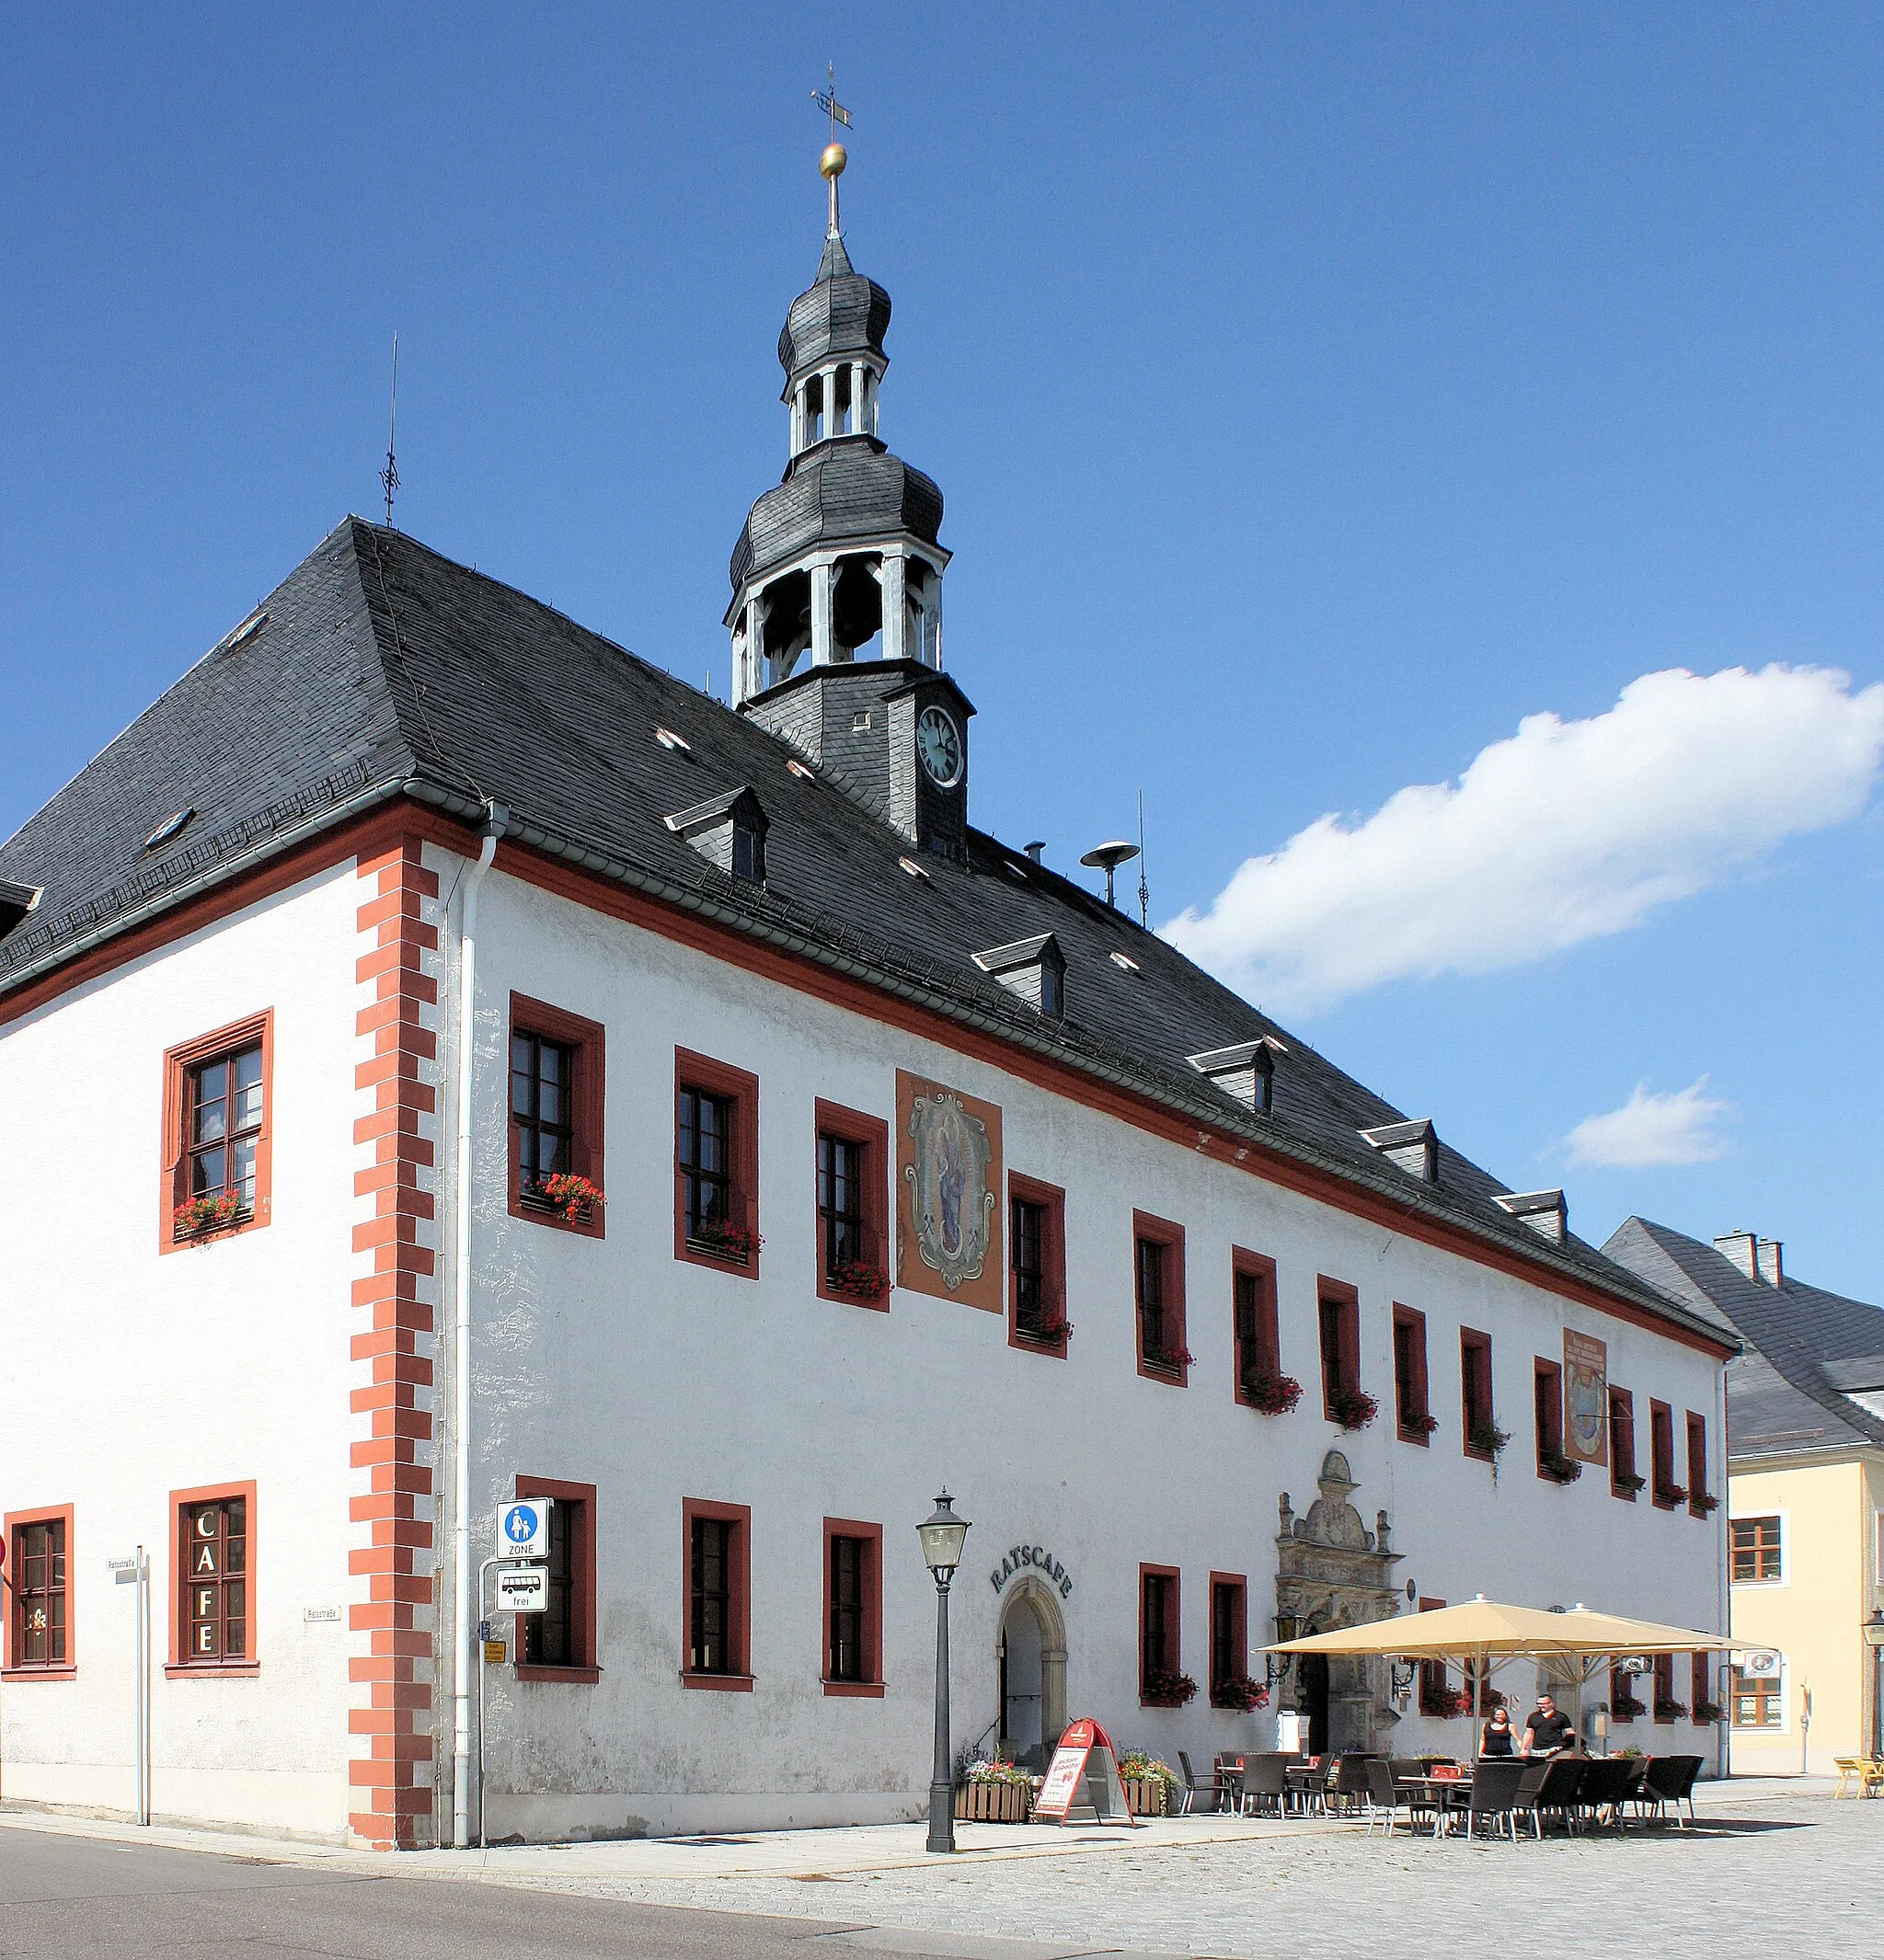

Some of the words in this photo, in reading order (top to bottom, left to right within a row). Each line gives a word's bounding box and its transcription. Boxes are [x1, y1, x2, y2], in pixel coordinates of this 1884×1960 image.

[509, 1544, 534, 1554] ZONE
[197, 1511, 215, 1651] CAFE
[991, 1545, 1073, 1599] RATSCAFE
[513, 1597, 529, 1606] frei
